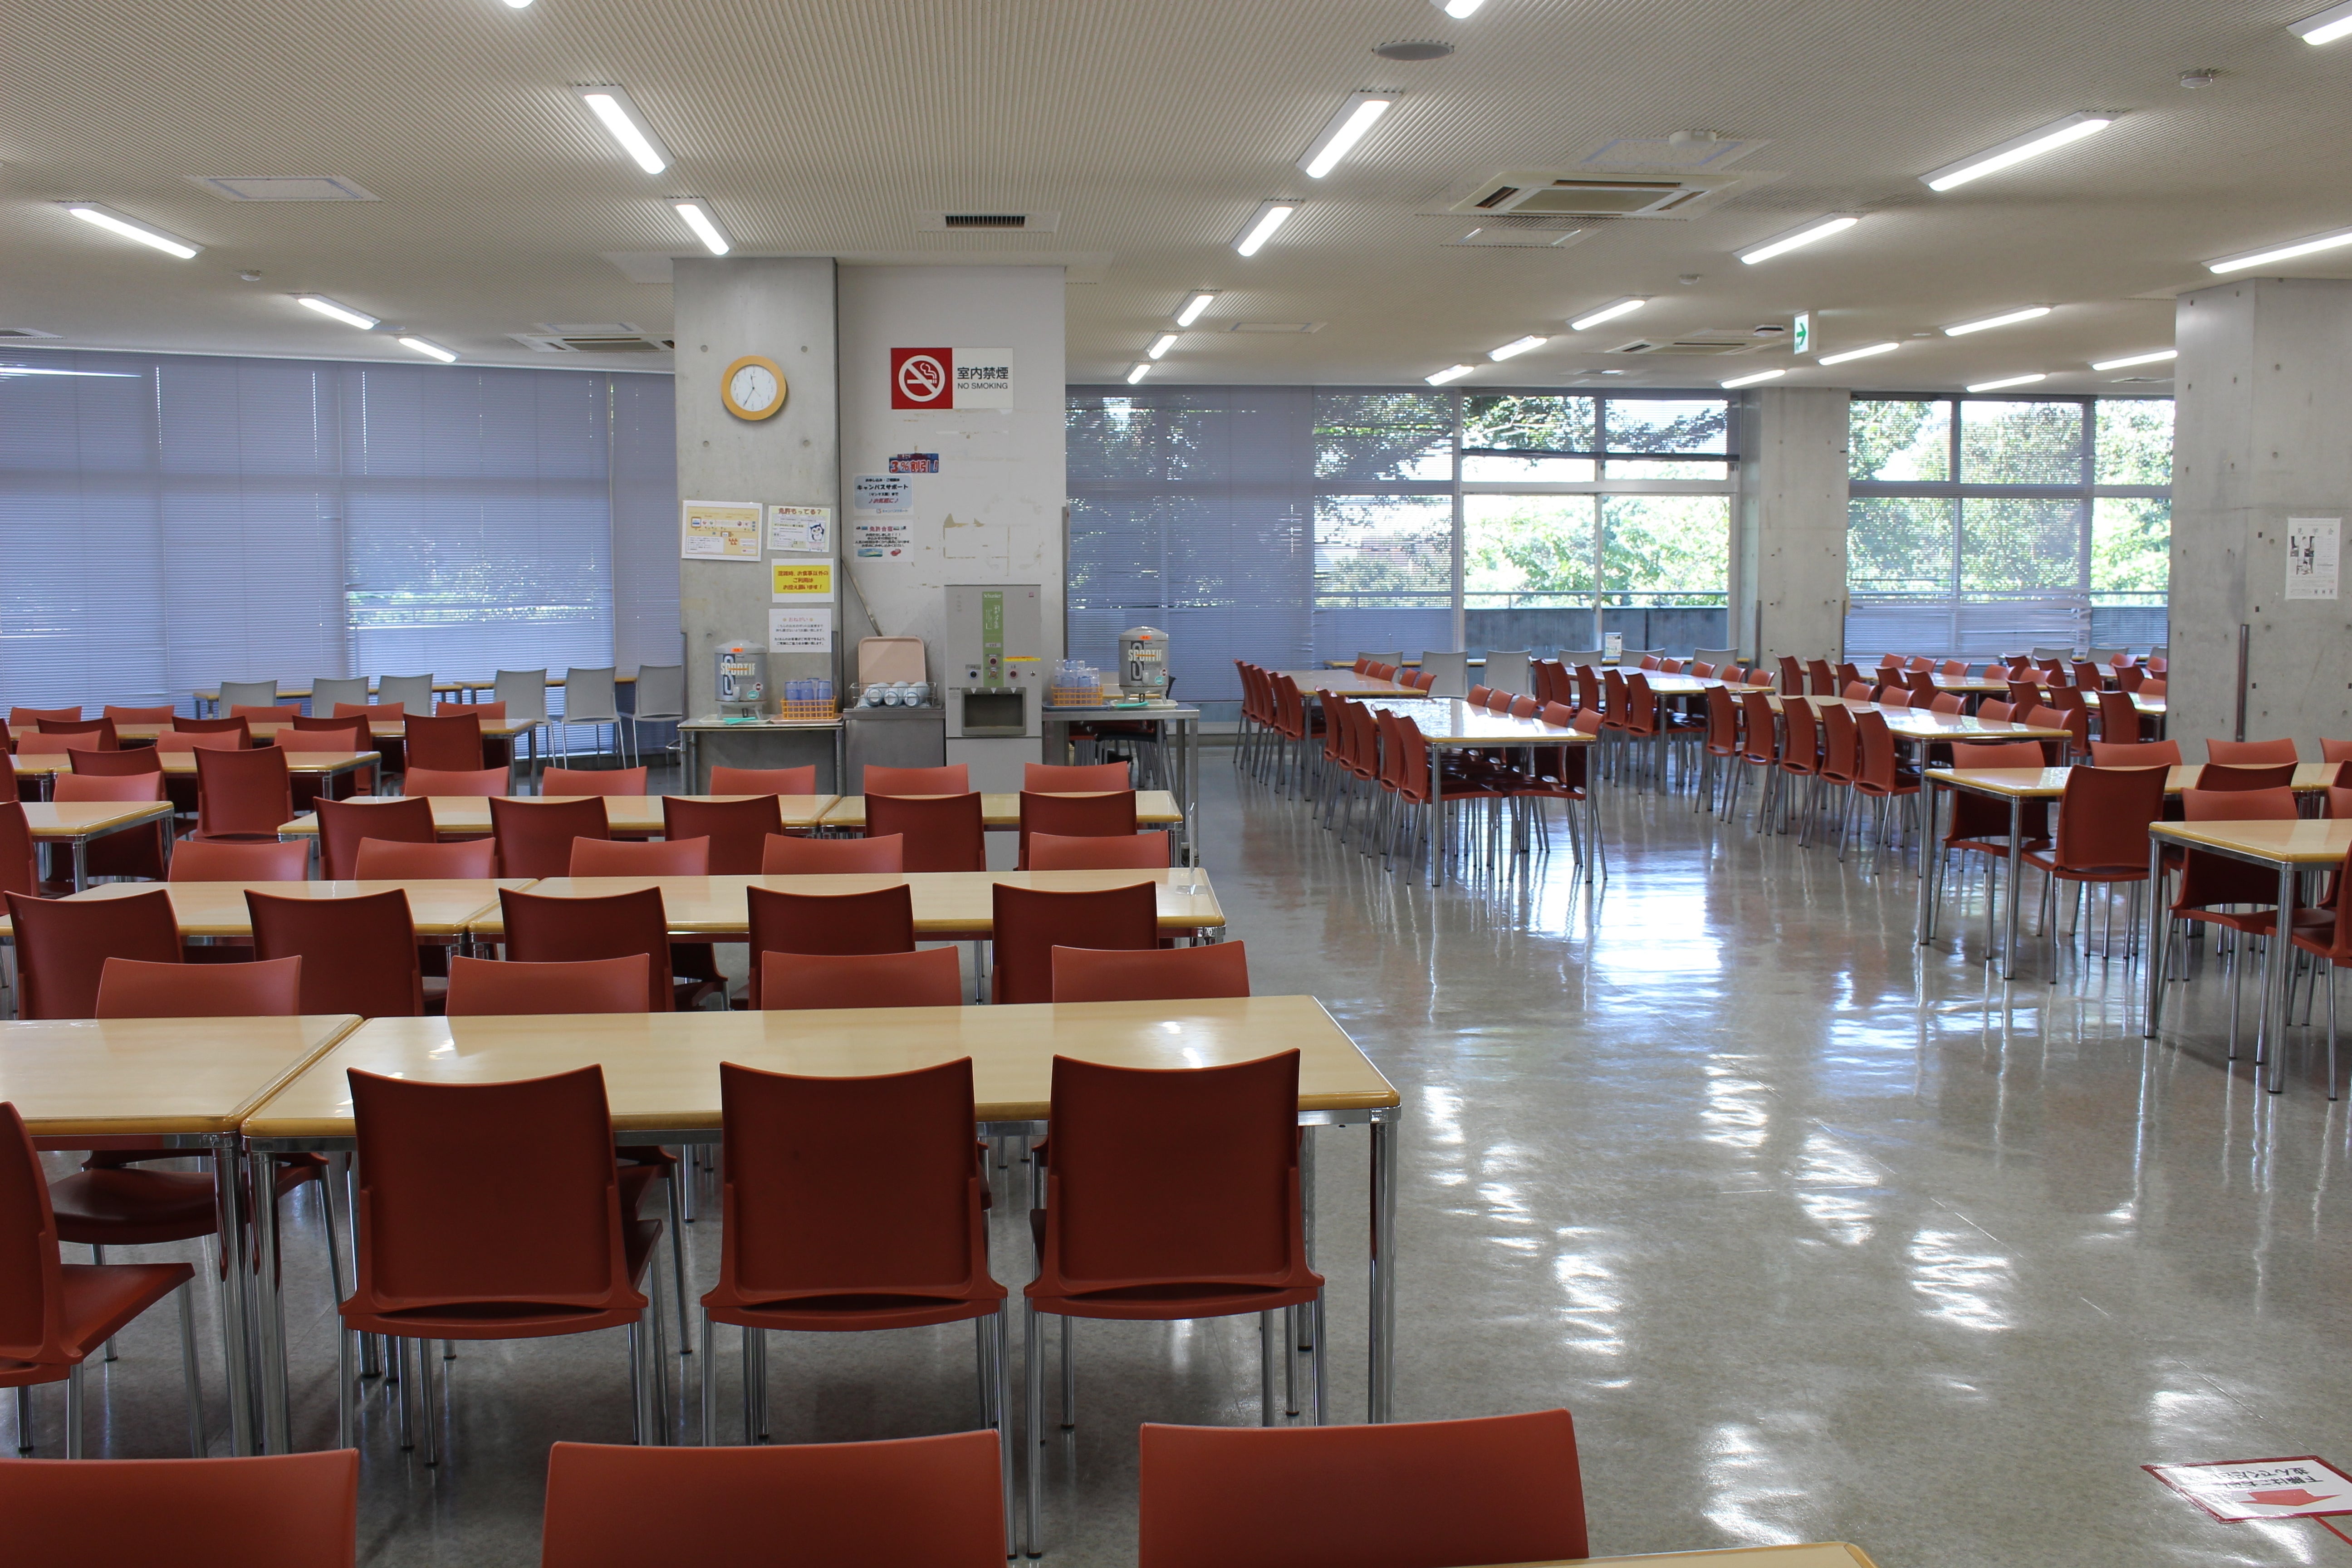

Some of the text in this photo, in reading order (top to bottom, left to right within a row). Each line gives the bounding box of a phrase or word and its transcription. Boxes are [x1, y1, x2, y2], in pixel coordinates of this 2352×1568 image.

[957, 367, 1008, 379] 室内禁煙
[1128, 649, 1162, 662] SPORTIF
[720, 662, 755, 676] SPORTIF
